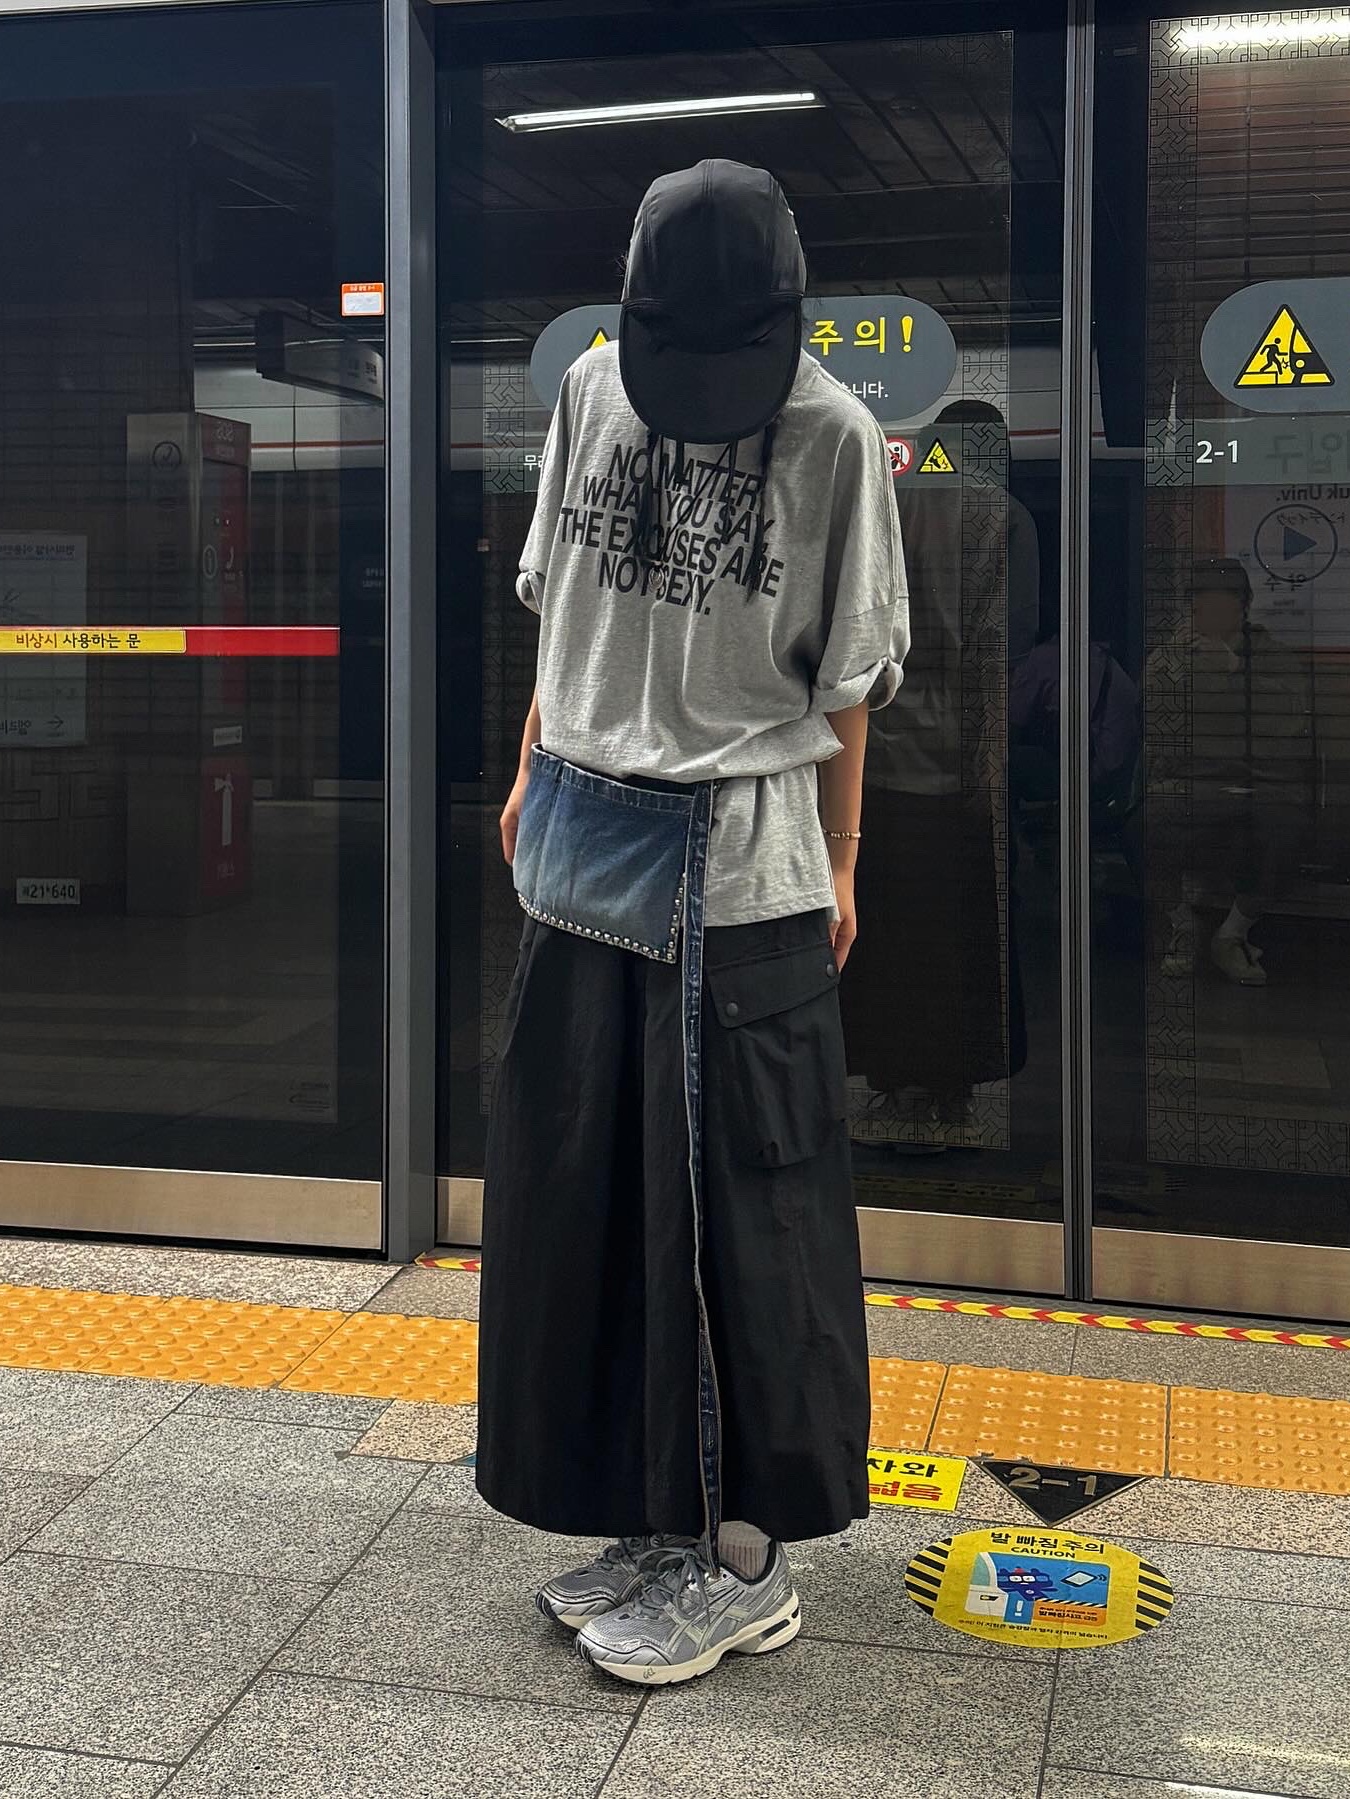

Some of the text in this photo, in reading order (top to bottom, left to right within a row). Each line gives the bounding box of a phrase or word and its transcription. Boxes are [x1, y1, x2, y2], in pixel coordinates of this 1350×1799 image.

[1195, 439, 1239, 464] 2-1
[608, 443, 767, 512] NO MATTER
[583, 475, 661, 514] WHA
[666, 491, 714, 529] YOU
[560, 507, 604, 549] THE
[720, 545, 785, 598] ARE
[598, 551, 716, 616] NOT SEXY.
[15, 633, 141, 649] 비상시 사용하는 문
[1008, 1466, 1097, 1497] 2-1
[991, 1532, 1105, 1555] 발 빠짐 주의
[1010, 1547, 1076, 1559] CAUTION
